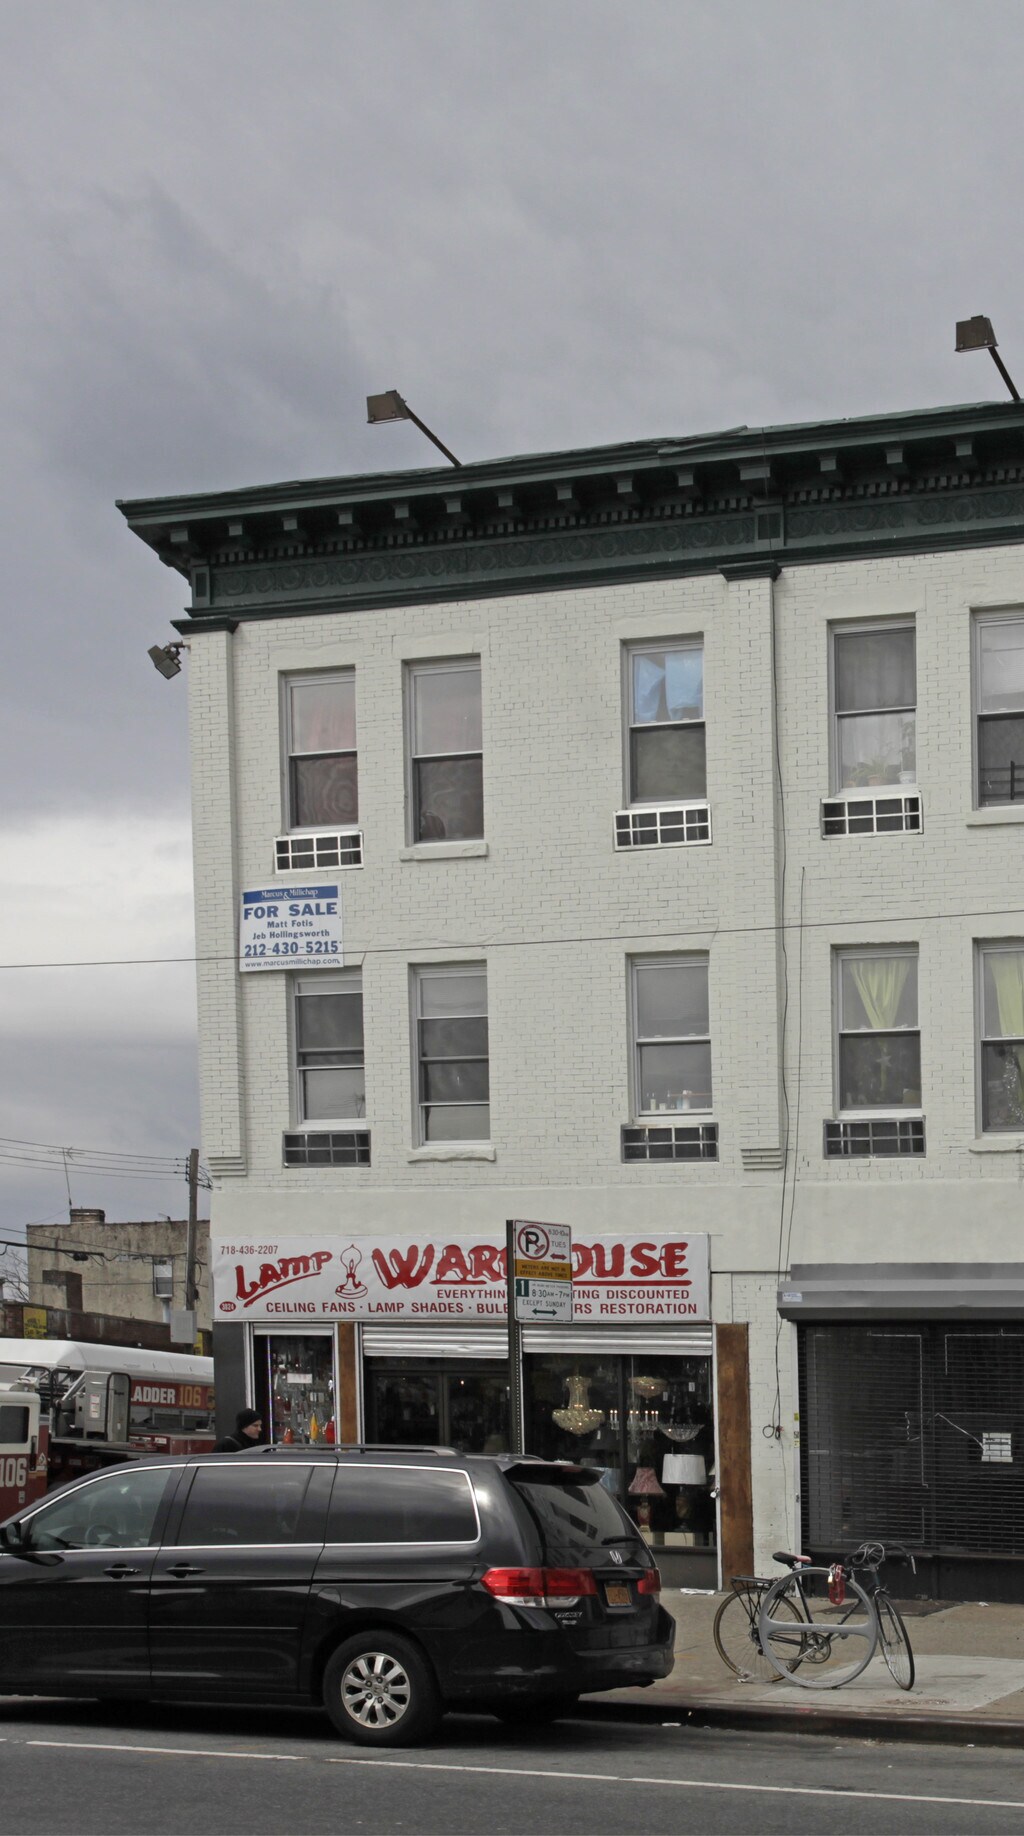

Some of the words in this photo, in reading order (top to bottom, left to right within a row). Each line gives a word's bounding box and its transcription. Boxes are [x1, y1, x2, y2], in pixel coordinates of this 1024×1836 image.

[261, 890, 283, 899] Marcus
[283, 892, 290, 900] &
[290, 889, 318, 898] Millichap
[244, 905, 278, 920] FOR
[289, 902, 337, 916] SALE
[253, 932, 266, 940] Jeb
[270, 929, 330, 939] Hollingsworth
[245, 941, 338, 957] 212-430-5215
[245, 959, 339, 968] www.marcusmillichap.com
[221, 1245, 278, 1255] 718-436-2207
[372, 1242, 688, 1289] WAROUSE
[520, 1280, 525, 1296] 1
[437, 1289, 505, 1299] EVERYTHIN
[607, 1290, 689, 1299] DISCOUNTED
[266, 1302, 316, 1312] CEILING
[322, 1302, 355, 1312] FANS
[368, 1303, 404, 1312] LAMP
[412, 1303, 463, 1313] SHADES
[600, 1303, 697, 1314] RESTORATION
[131, 1386, 176, 1404] ADDER
[179, 1385, 201, 1406] 106
[0, 1458, 27, 1487] 106
